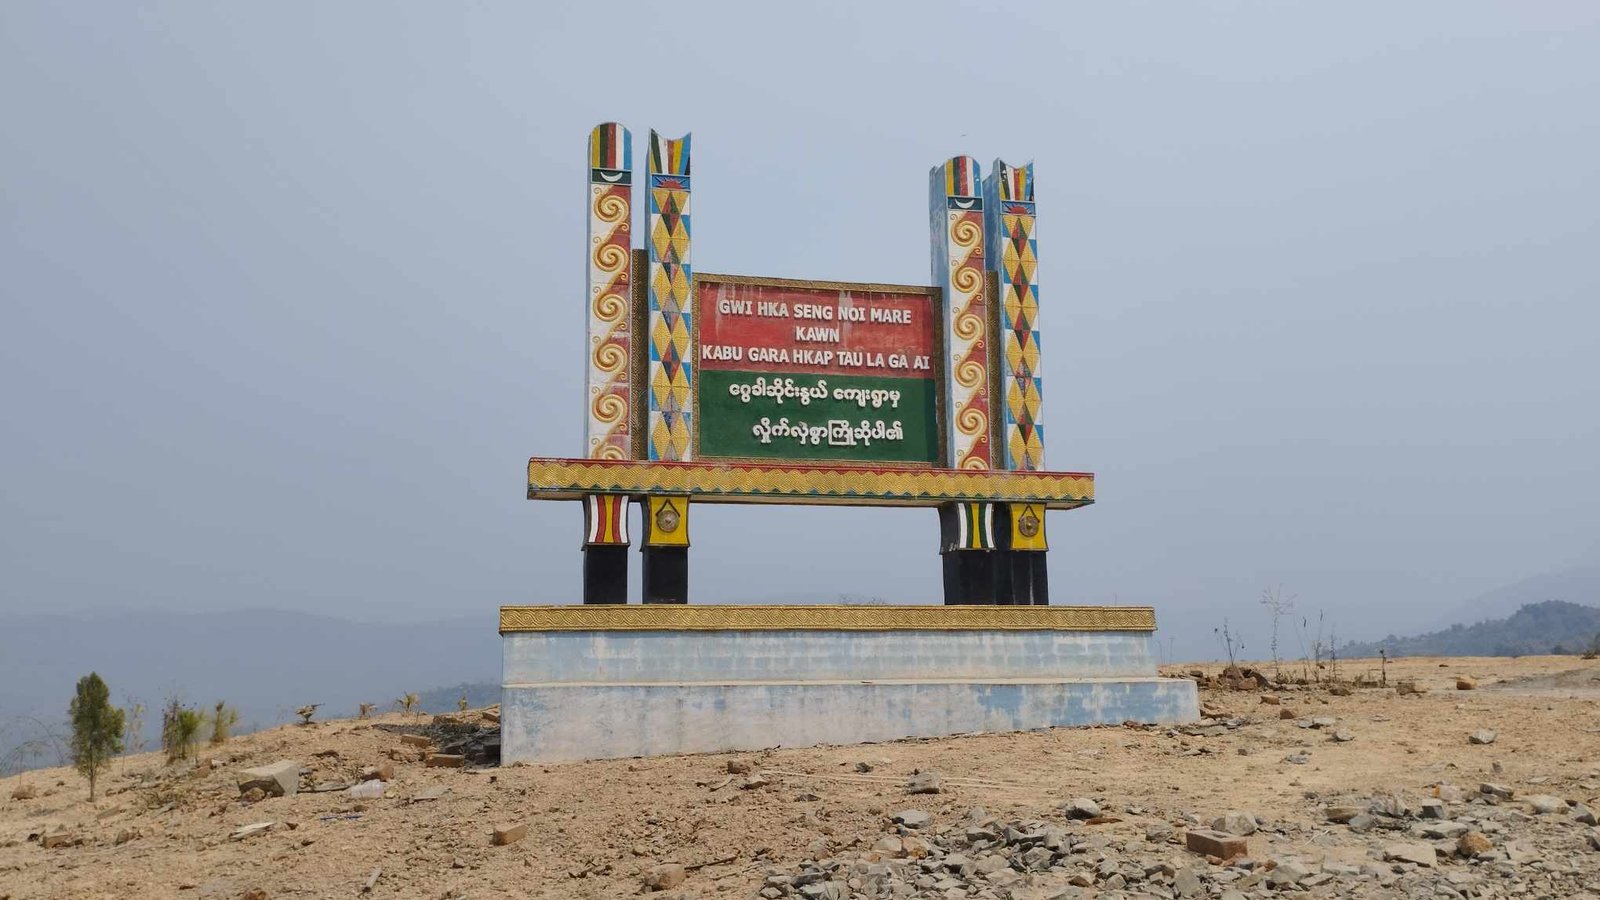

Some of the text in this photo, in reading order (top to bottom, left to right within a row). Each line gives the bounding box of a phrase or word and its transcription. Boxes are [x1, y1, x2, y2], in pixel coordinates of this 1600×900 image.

[719, 299, 912, 324] GWI HKA SENG NOI MARE
[795, 326, 840, 343] KAWN
[702, 345, 930, 370] KABU GARA HKAP TAU LA GA AI
